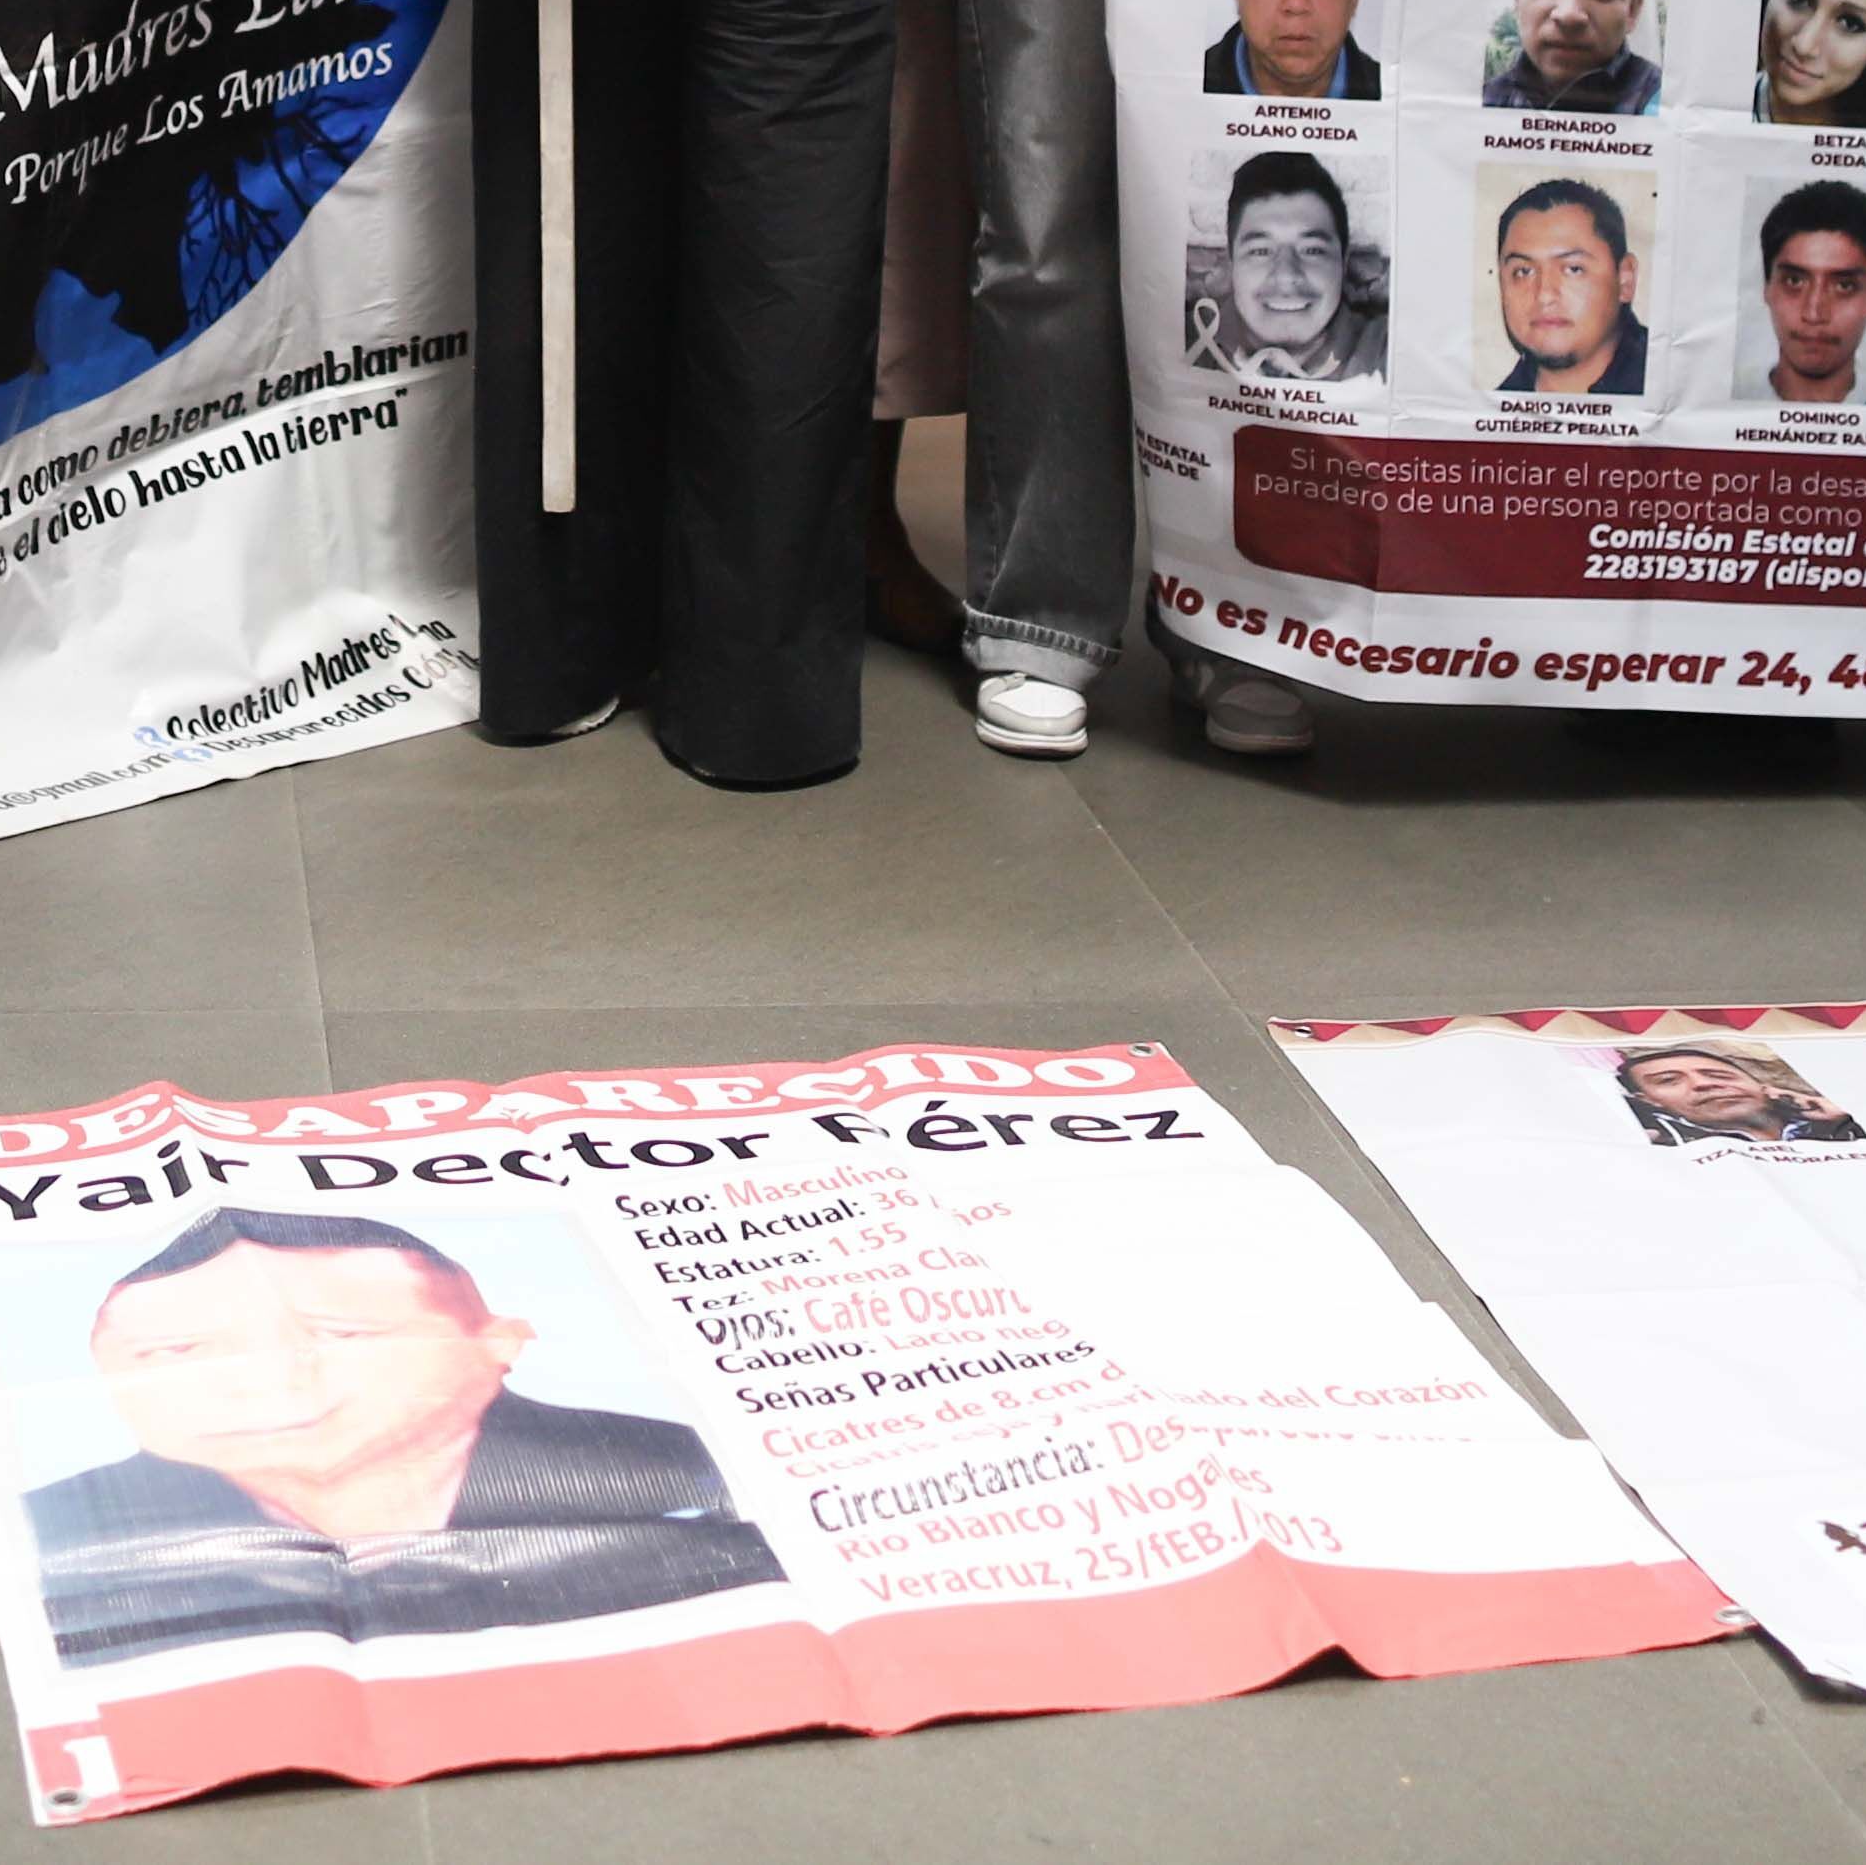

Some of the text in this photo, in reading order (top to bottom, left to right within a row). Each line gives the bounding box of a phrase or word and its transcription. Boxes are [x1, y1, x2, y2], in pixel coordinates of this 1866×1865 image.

[5, 122, 128, 205] Porque
[137, 94, 205, 146] Los
[218, 42, 393, 119] Amamos
[1734, 425, 1835, 447] HERNÁNDEZ
[1778, 409, 1862, 428] DOMINGO
[13, 517, 41, 563] el
[47, 486, 127, 543] cielo
[129, 445, 246, 508] hasta
[246, 430, 280, 466] la
[18, 445, 98, 506] como
[1583, 553, 1761, 584] 2283193187
[1587, 522, 1738, 558] Comisión
[1741, 529, 1859, 560] Estatal
[1216, 599, 1269, 637] es
[1278, 615, 1520, 681] necesario
[1533, 651, 1726, 692] esperar
[1736, 651, 1812, 695] 24,
[166, 626, 401, 740] Colectivo Madres
[614, 1162, 911, 1225] Sexo: Masculino
[634, 1196, 866, 1253] Edad Actual:
[735, 1337, 1098, 1417] Señas Particulares
